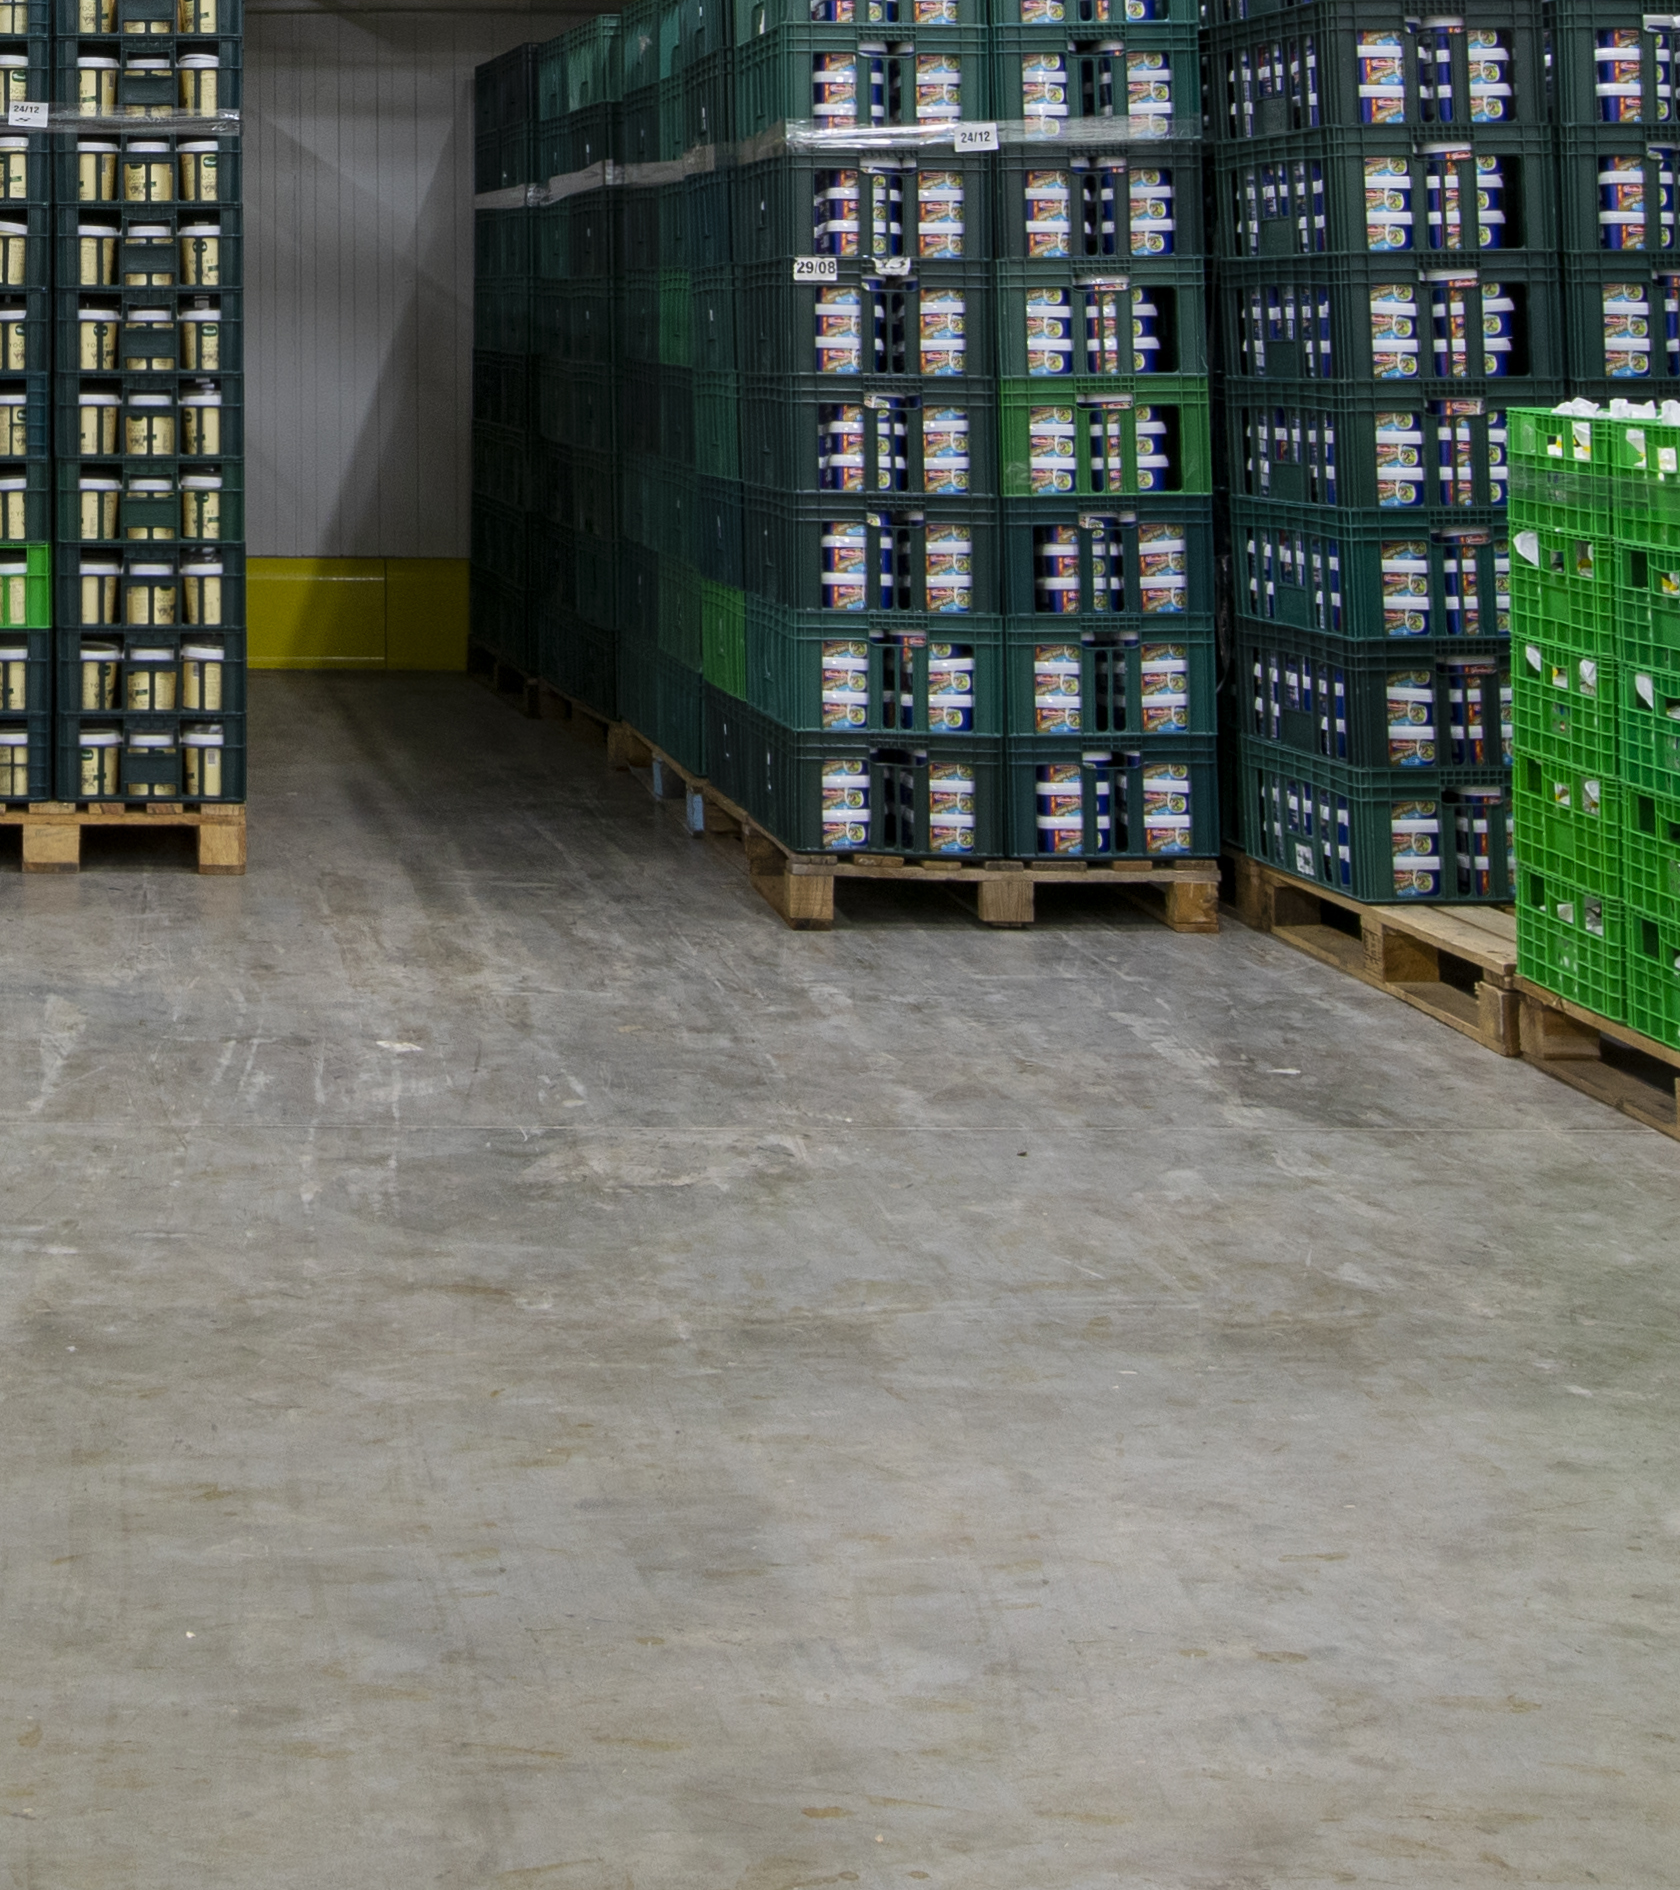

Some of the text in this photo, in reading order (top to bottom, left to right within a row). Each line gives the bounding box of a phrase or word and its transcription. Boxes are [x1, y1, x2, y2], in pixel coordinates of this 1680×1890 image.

[14, 105, 40, 113] 24/12
[961, 131, 990, 143] 24/12
[797, 262, 836, 274] 29/08
